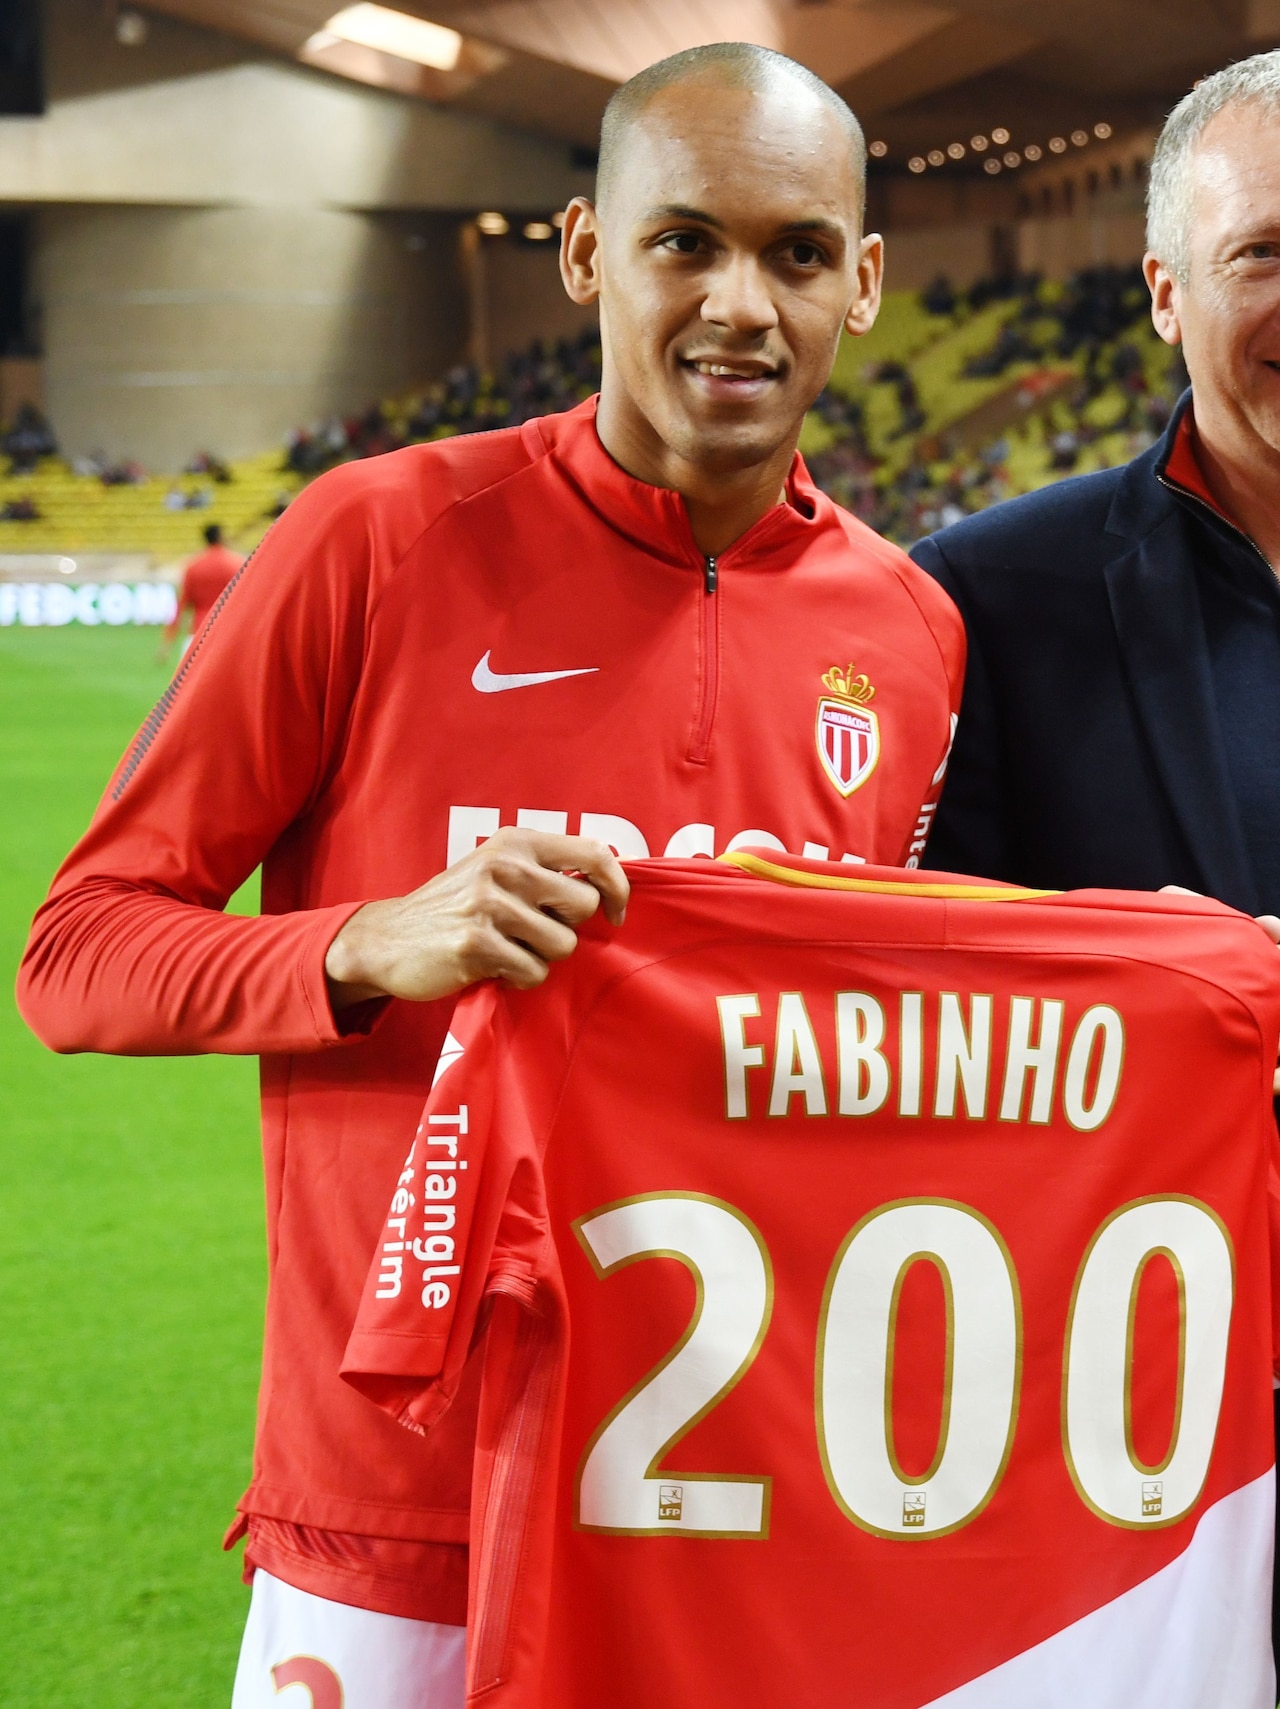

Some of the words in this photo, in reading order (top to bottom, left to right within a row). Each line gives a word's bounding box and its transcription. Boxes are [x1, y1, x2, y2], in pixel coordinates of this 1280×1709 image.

[716, 989, 1126, 1132] FABINHO
[421, 1105, 469, 1310] Triangle
[571, 1190, 1235, 1541] 200
[659, 1507, 681, 1517] LFP
[903, 1514, 925, 1523] LFP
[1142, 1503, 1161, 1513] LFP
